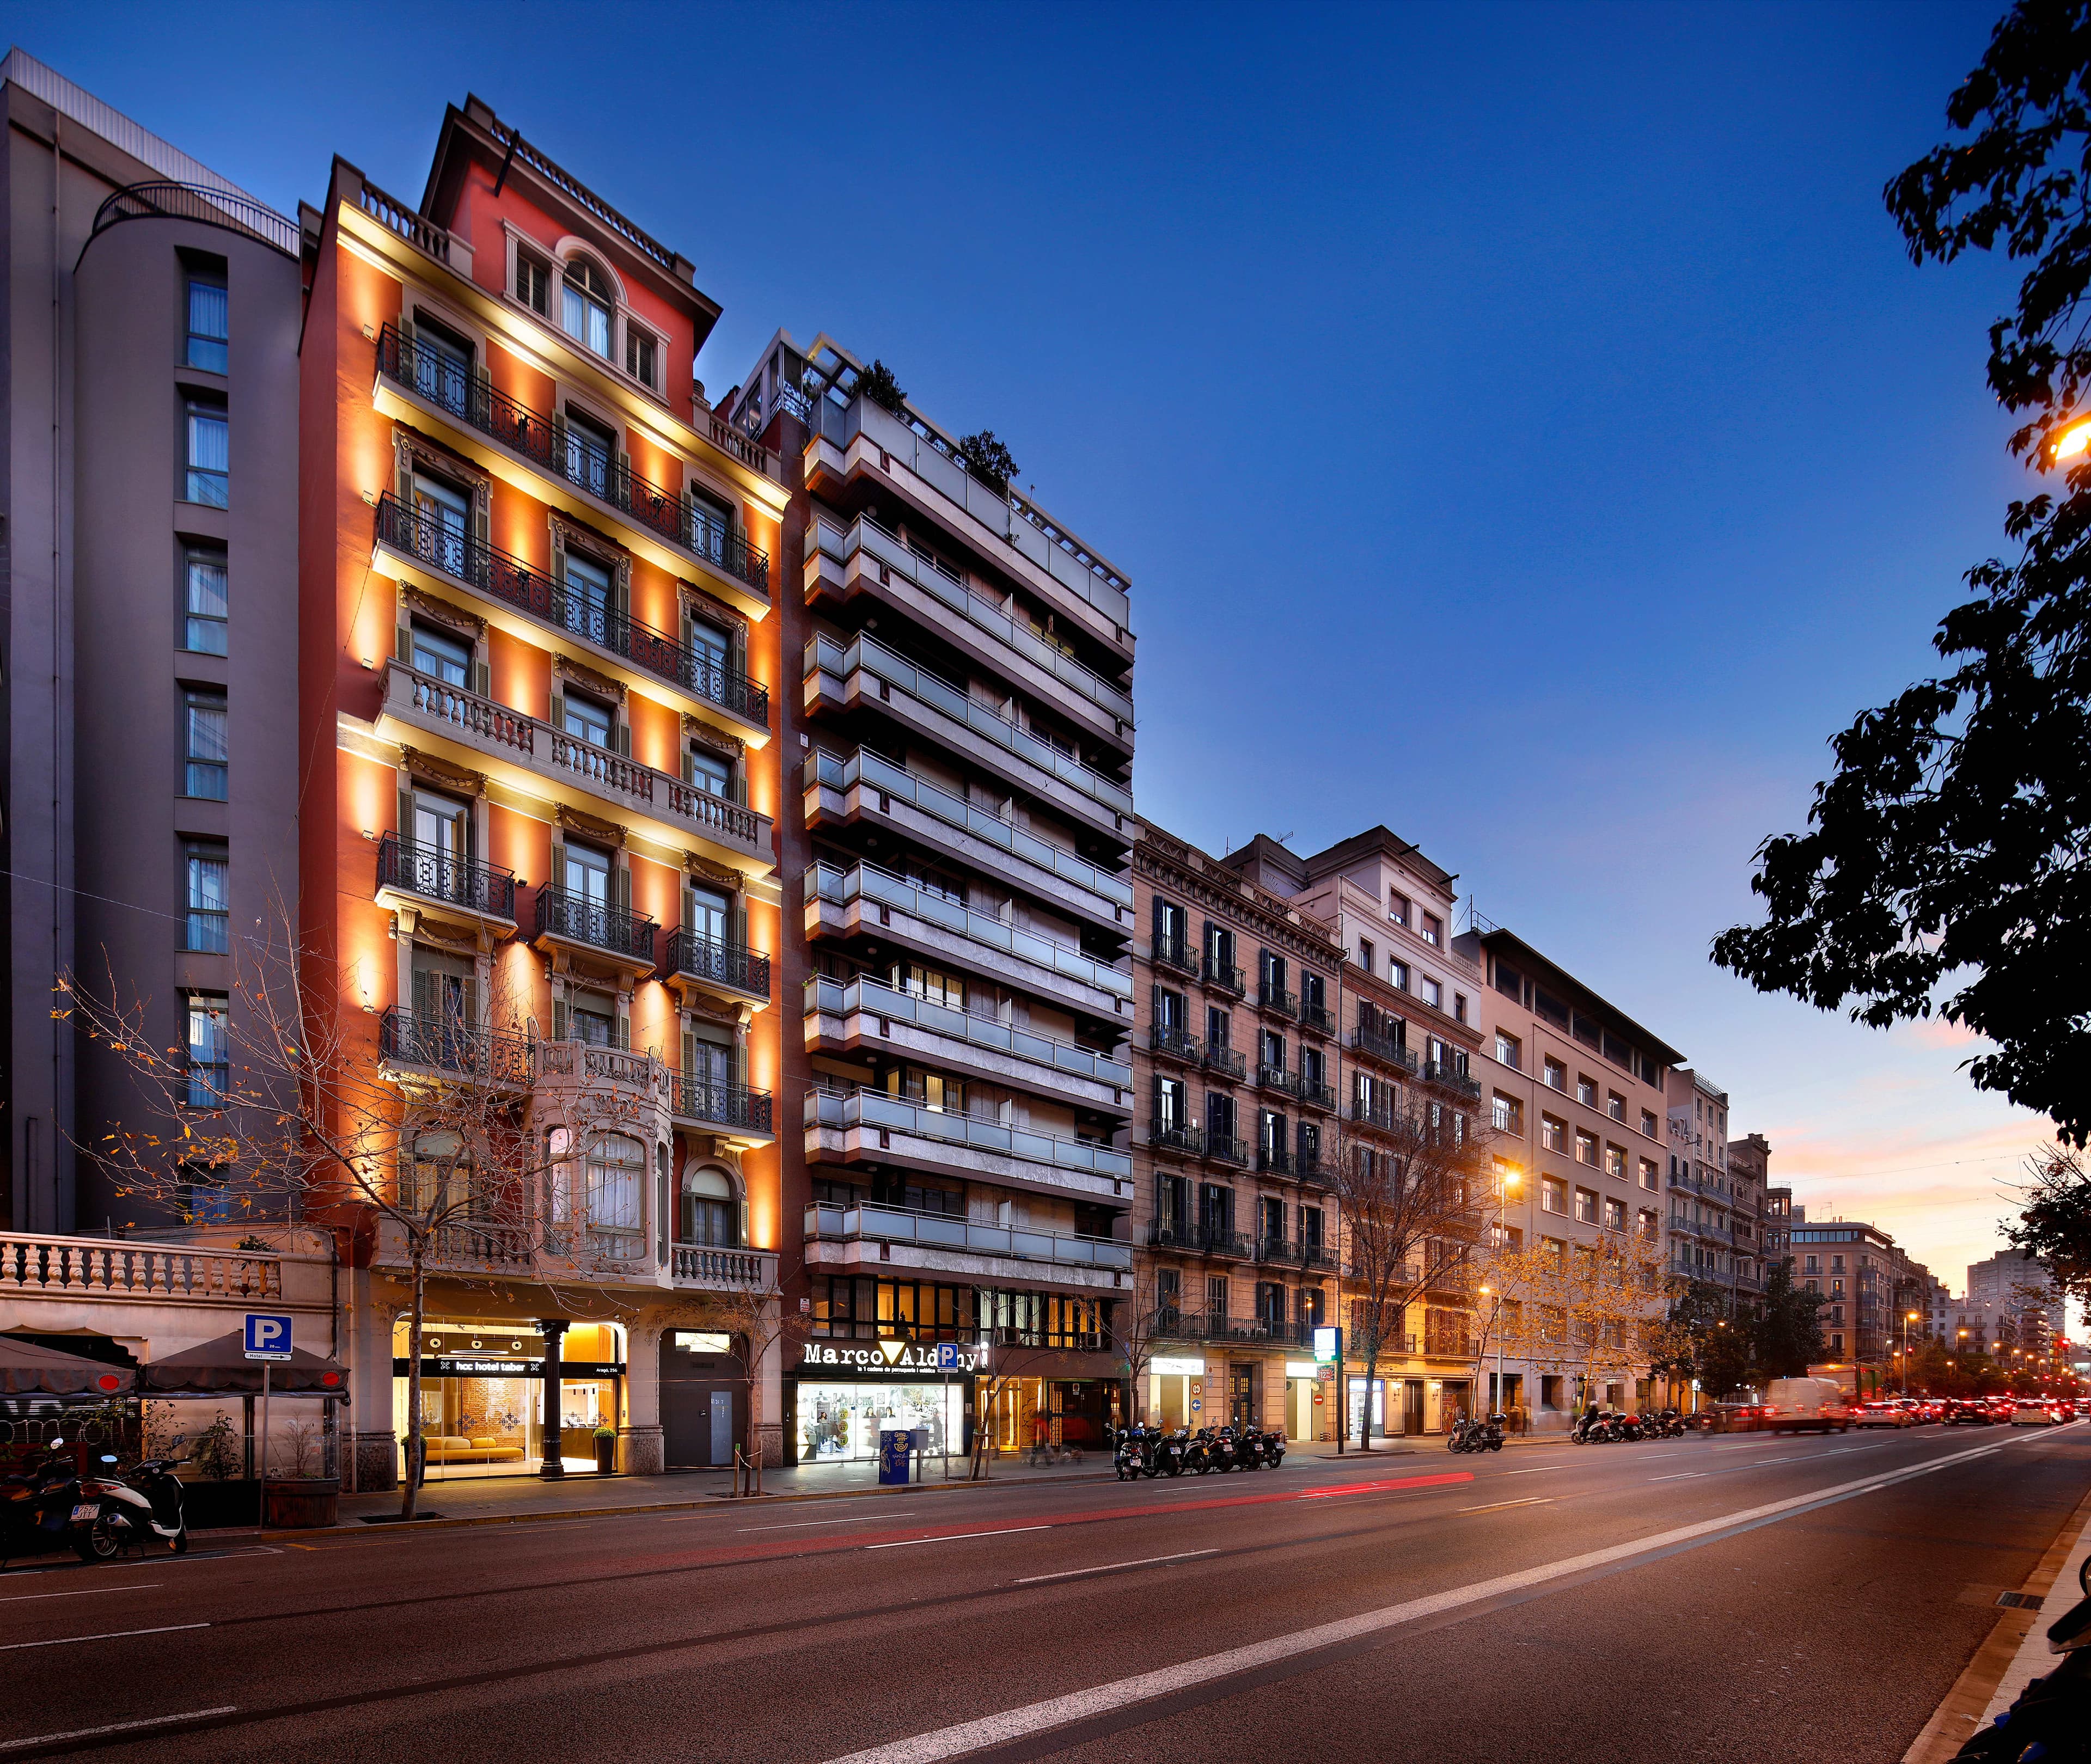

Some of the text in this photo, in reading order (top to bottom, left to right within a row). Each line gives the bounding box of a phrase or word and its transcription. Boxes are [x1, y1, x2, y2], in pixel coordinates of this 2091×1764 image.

[255, 1319, 282, 1347] P
[456, 1362, 525, 1371] hcc hotel taber
[803, 1343, 978, 1371] Marco Aldny
[942, 1346, 953, 1365] P
